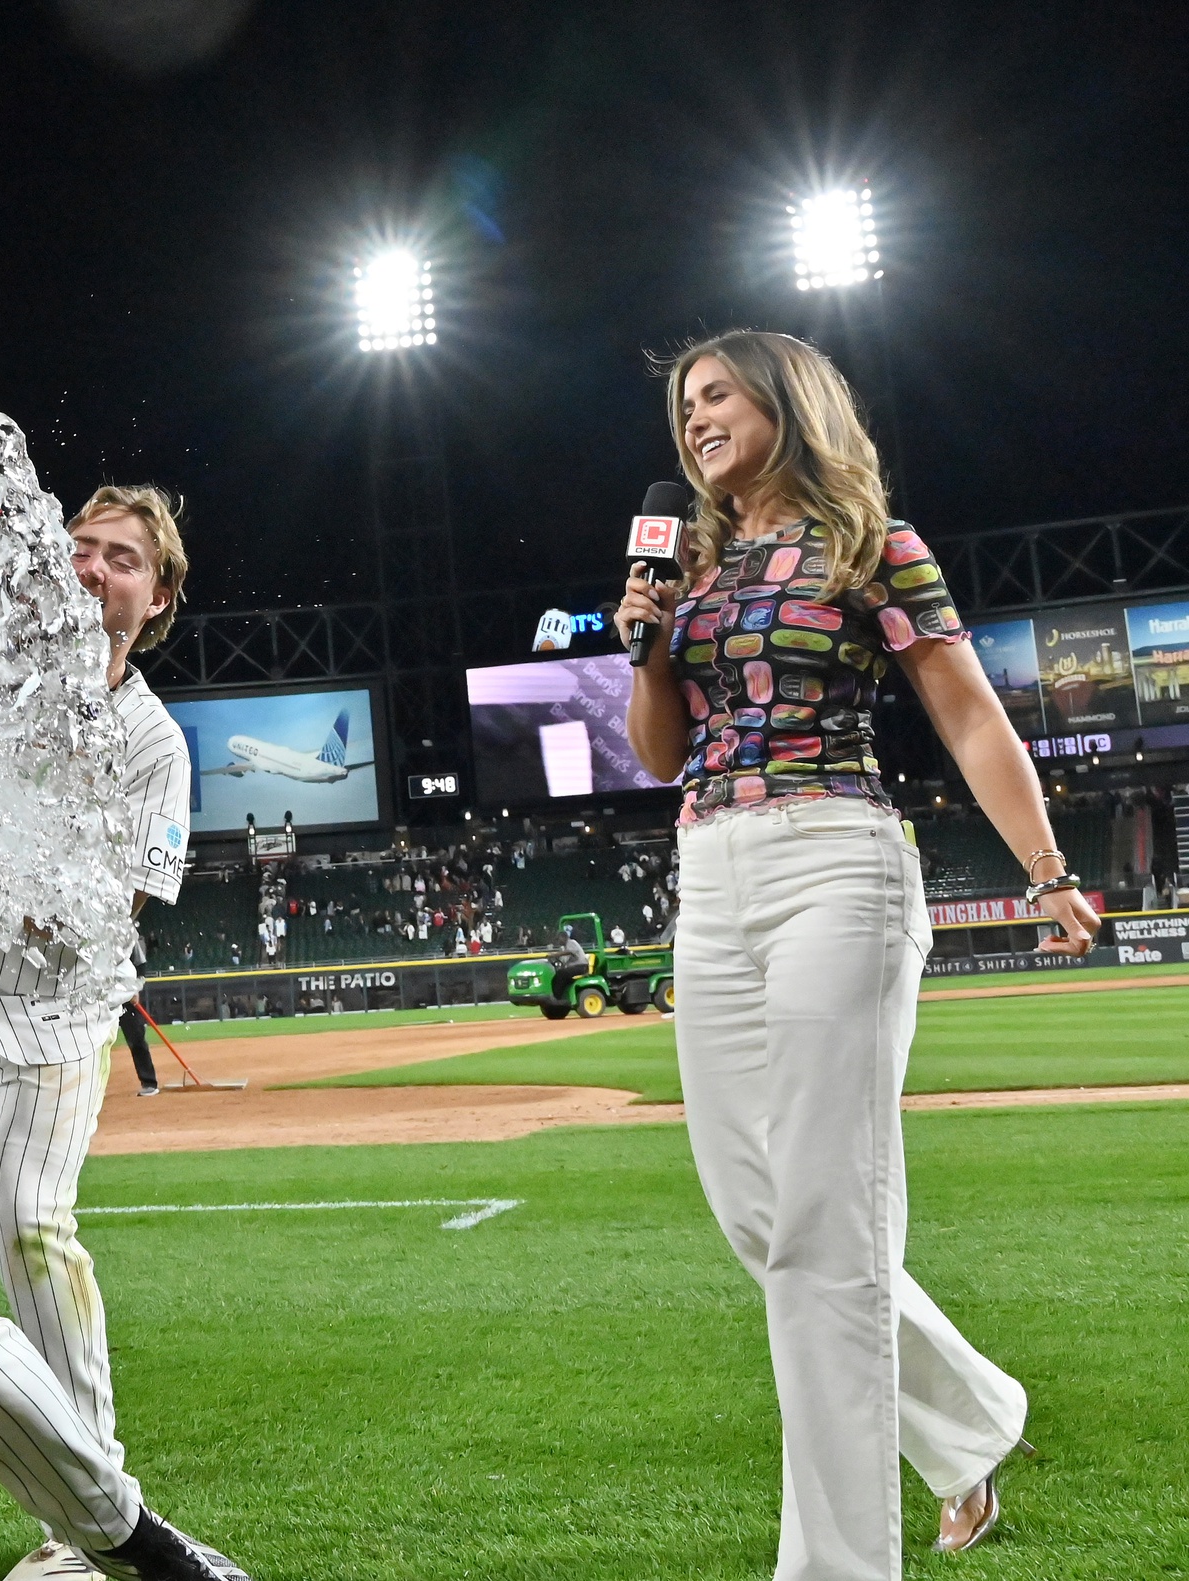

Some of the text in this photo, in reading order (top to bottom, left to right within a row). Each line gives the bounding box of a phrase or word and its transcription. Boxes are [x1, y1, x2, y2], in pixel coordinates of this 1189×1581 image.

[540, 617, 569, 635] Lite
[570, 612, 603, 633] IT'S
[1061, 627, 1116, 640] HORSESHOE
[232, 742, 259, 757] UNITED
[422, 776, 456, 795] 9:48
[147, 846, 185, 880] CME
[1013, 898, 1047, 919] ME
[1116, 926, 1187, 940] WELLNESS
[1118, 945, 1163, 963] Rate
[925, 962, 960, 974] SHIFT
[979, 959, 1015, 971] SHIFT
[1035, 955, 1071, 967] SHIFT
[298, 972, 396, 991] THE PATIO
